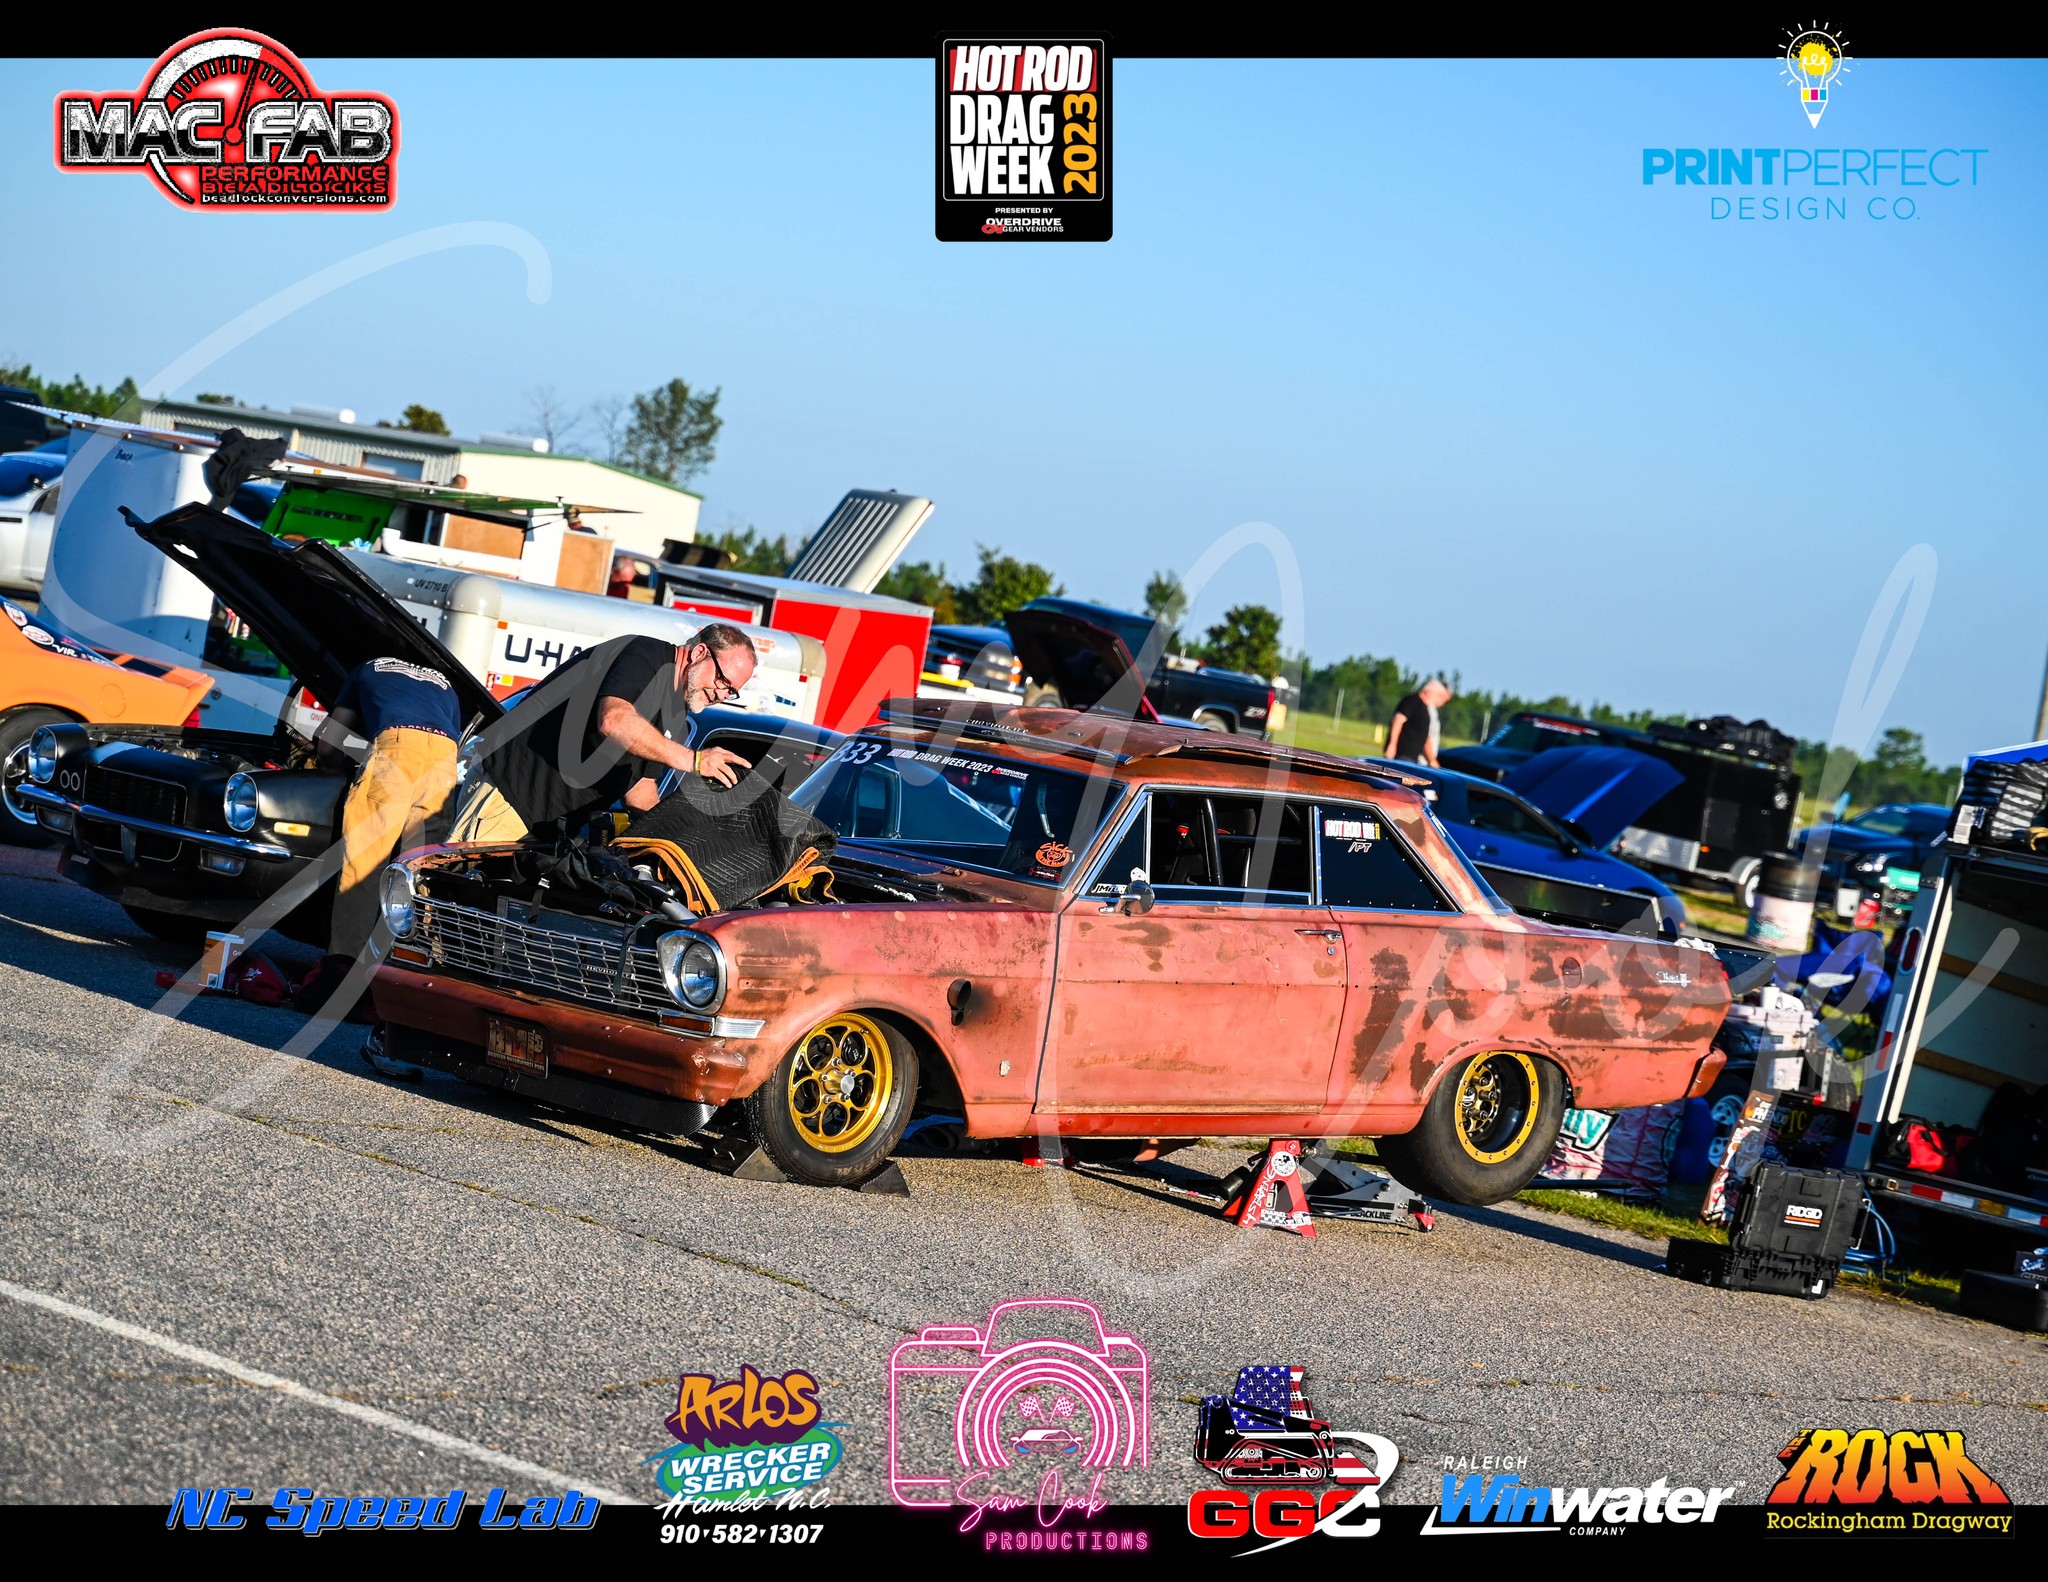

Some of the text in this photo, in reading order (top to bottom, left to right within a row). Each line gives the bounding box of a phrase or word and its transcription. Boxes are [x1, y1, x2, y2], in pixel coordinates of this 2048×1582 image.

[915, 752, 941, 764] DRAG
[941, 755, 969, 769] WEEK
[966, 761, 993, 774] 2023
[1786, 1204, 1823, 1220] RIDGID
